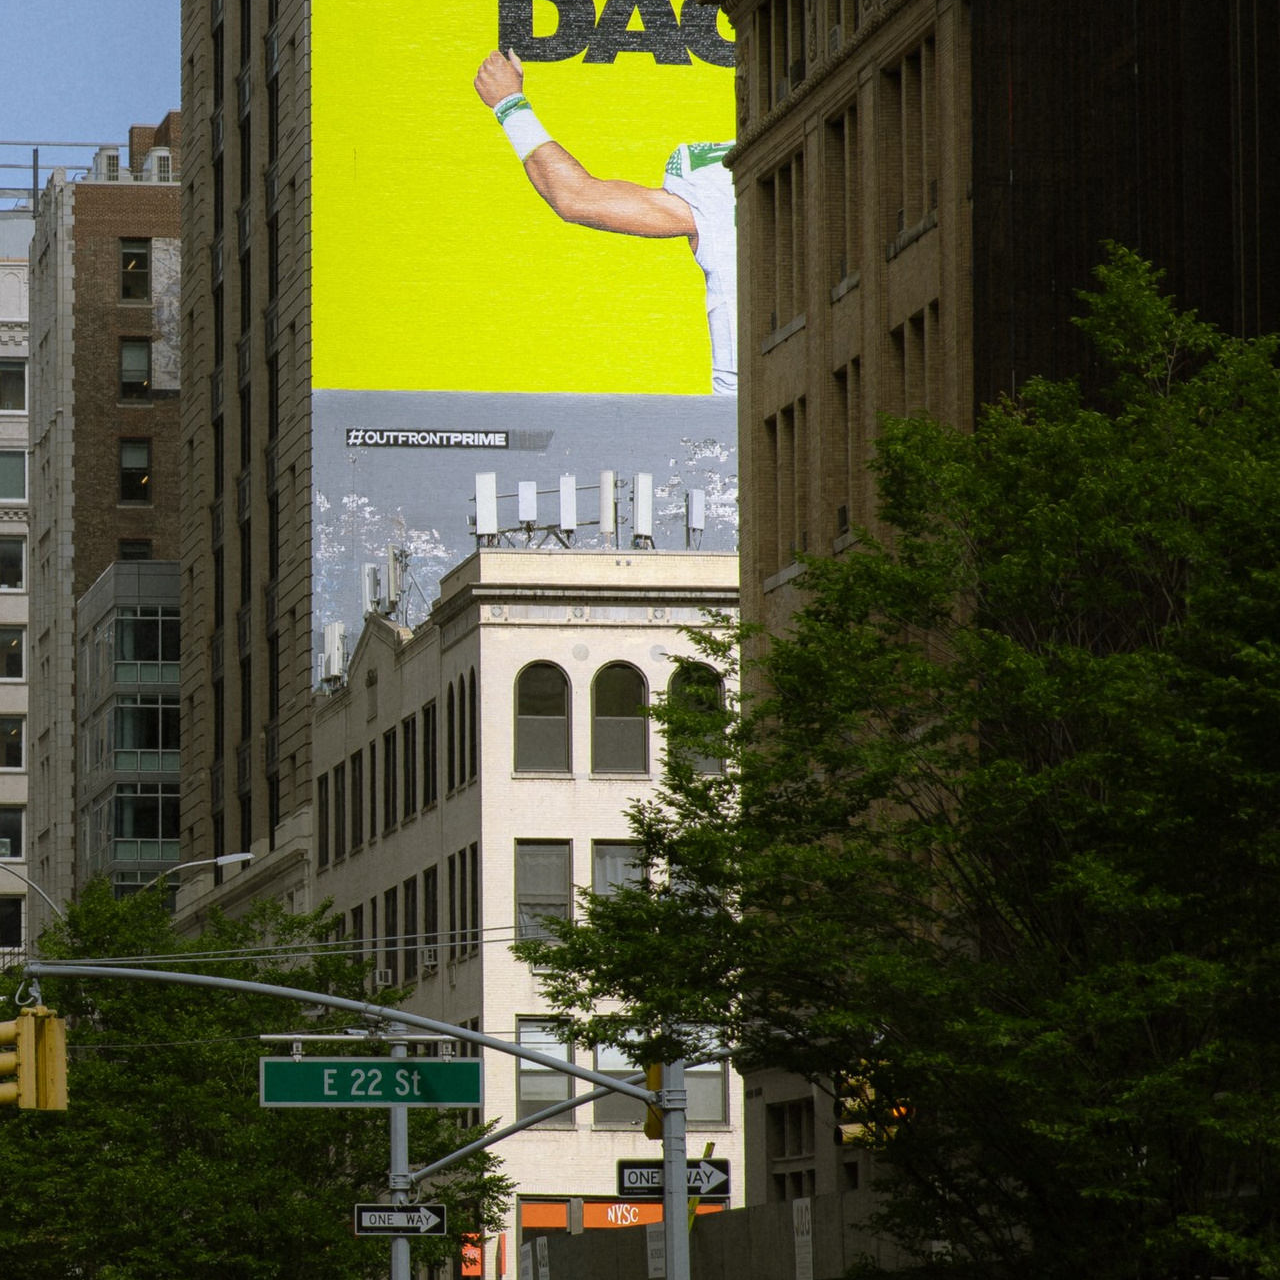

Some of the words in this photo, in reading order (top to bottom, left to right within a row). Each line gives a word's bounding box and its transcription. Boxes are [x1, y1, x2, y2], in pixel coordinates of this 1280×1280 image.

[347, 429, 507, 447] #OUTFRONTPRIME
[322, 1068, 337, 1096] E
[348, 1068, 383, 1096] 22
[394, 1068, 421, 1097] St
[628, 1170, 660, 1185] ONE
[369, 1213, 394, 1225] ONE
[405, 1214, 431, 1225] WAY
[607, 1203, 639, 1225] NYSC
